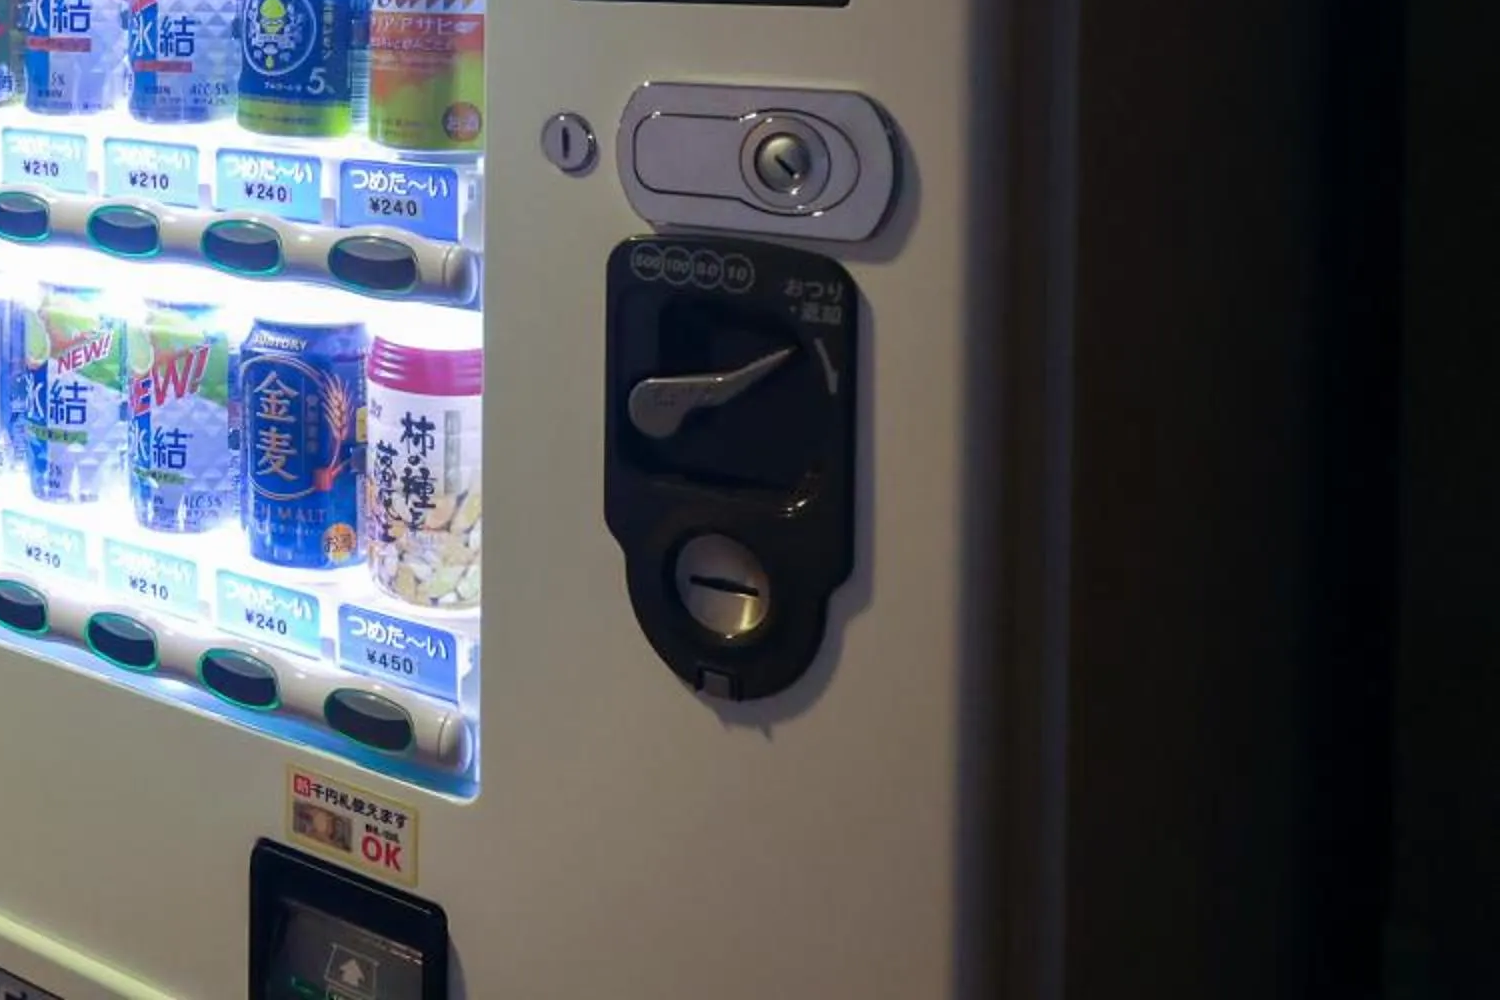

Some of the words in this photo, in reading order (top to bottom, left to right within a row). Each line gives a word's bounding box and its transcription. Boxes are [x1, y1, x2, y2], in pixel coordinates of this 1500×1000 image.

[131, 13, 195, 57] 氷結
[23, 160, 59, 177] ¥210
[129, 170, 170, 190] ¥210
[245, 184, 287, 202] ¥240
[369, 198, 418, 217] ¥240
[253, 370, 299, 481] 金麦
[129, 576, 169, 601] ¥210
[245, 608, 287, 635] ¥240
[366, 649, 414, 675] ¥450
[361, 834, 403, 873] OK
